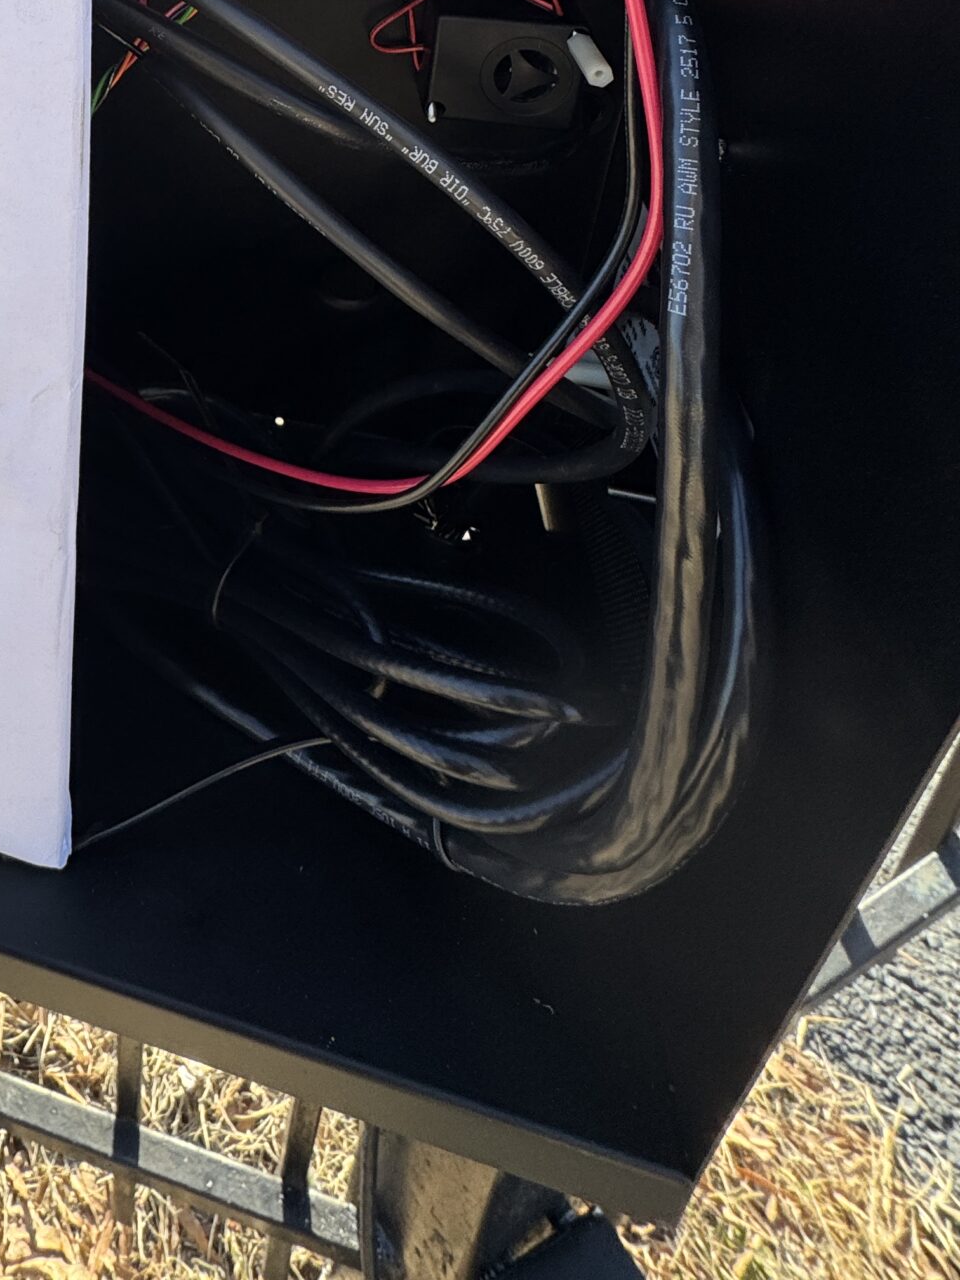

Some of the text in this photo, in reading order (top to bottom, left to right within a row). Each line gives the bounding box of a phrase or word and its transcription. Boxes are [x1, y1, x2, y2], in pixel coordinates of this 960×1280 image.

[680, 34, 700, 80] 2517
[679, 89, 701, 148] STYLE
[677, 158, 698, 195] AWM
[674, 205, 696, 231] RU
[509, 240, 545, 270] 600V
[668, 240, 692, 317] E56702
